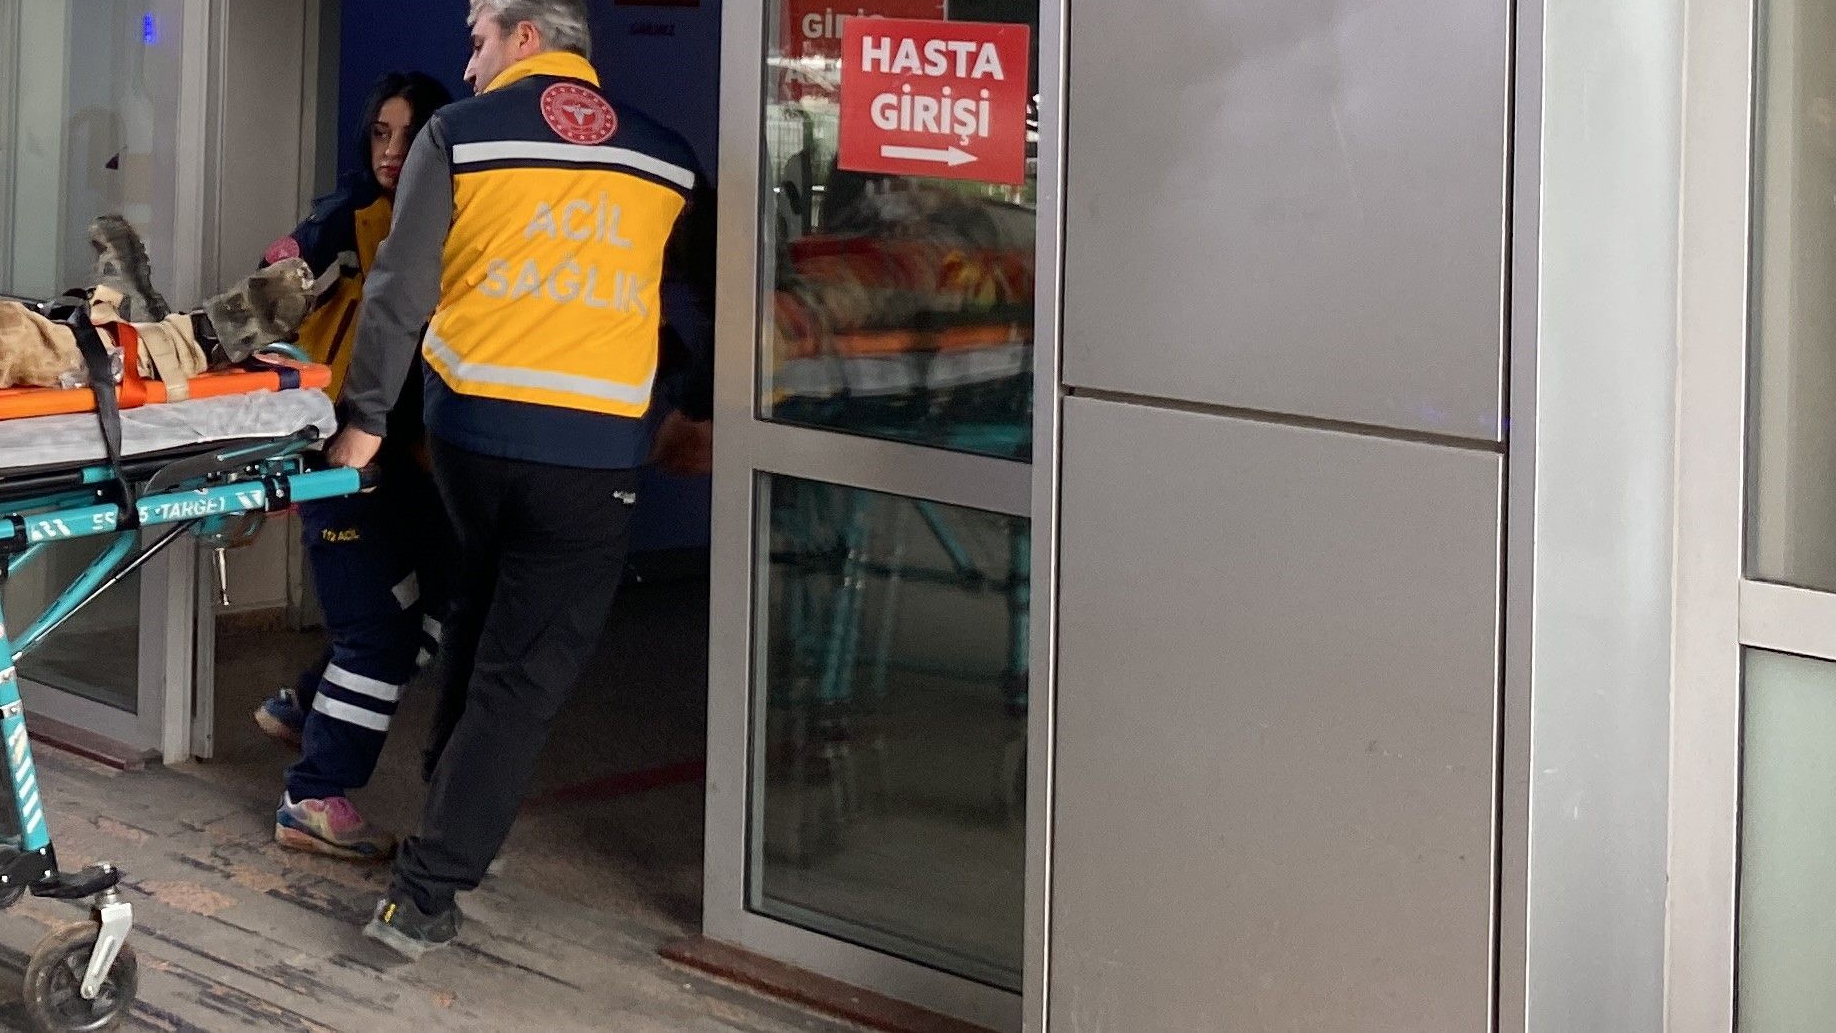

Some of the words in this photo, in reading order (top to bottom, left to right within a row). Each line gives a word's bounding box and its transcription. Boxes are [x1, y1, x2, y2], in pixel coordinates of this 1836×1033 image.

[862, 36, 1005, 80] HASTA
[870, 83, 990, 146] GİRİŞİ
[523, 190, 634, 248] ACİL
[478, 251, 649, 320] SAĞLIK
